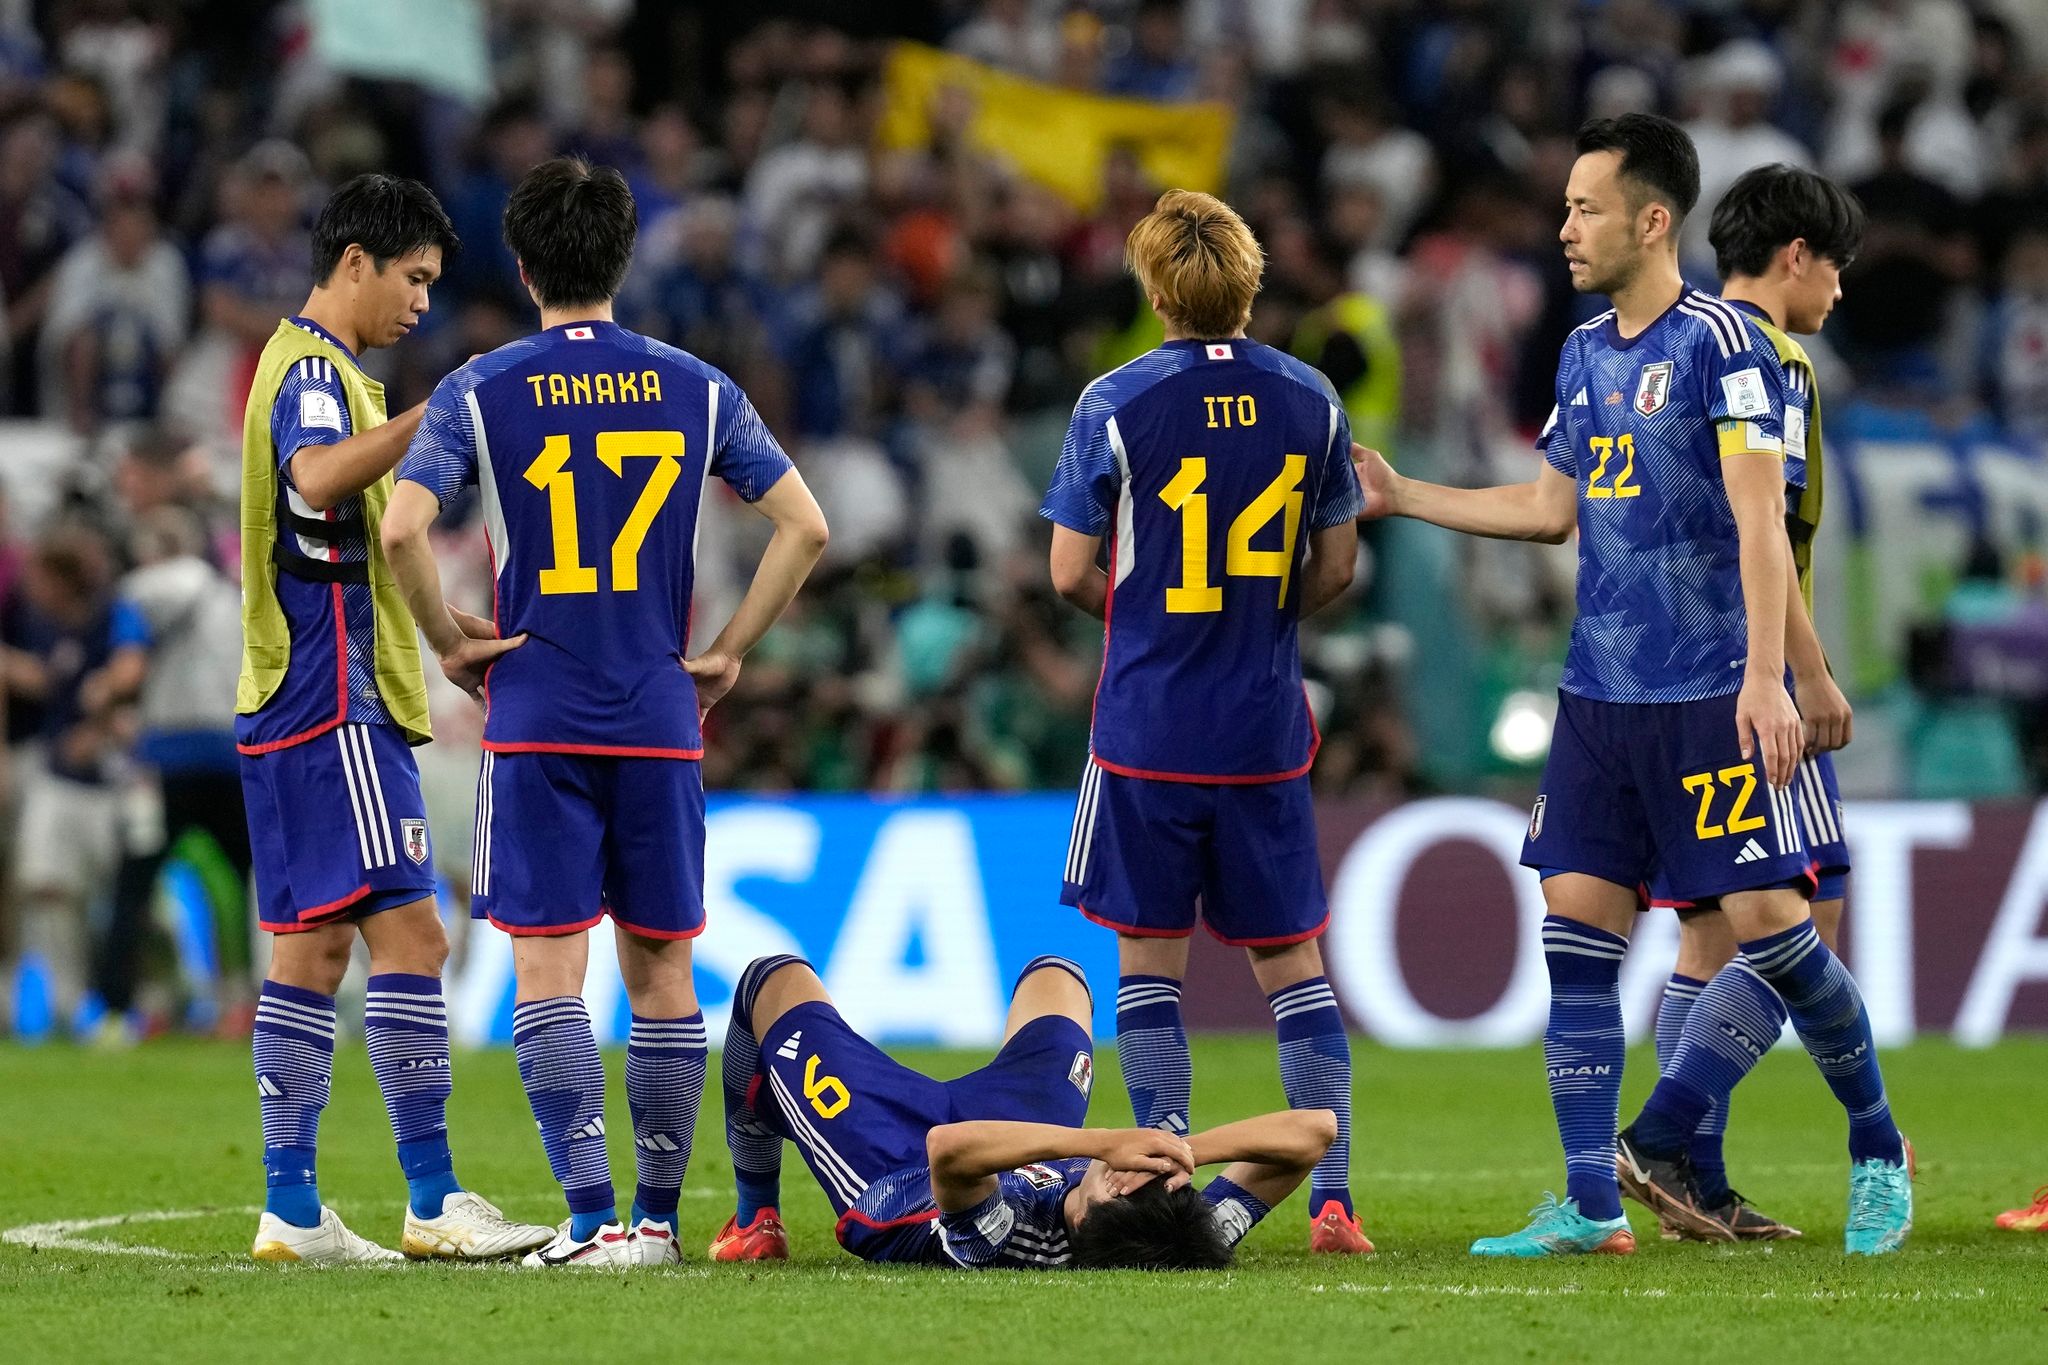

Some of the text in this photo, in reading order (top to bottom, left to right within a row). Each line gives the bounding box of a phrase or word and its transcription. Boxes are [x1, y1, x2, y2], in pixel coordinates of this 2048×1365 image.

[527, 370, 662, 407] TANAKA
[1204, 395, 1257, 428] ITO
[1586, 433, 1641, 499] 22
[523, 431, 685, 595] 17
[1158, 454, 1307, 613] 14
[1682, 763, 1767, 840] 22
[1720, 1026, 1761, 1060] JAP
[401, 1058, 450, 1071] JAP
[1548, 1064, 1611, 1078] APAN
